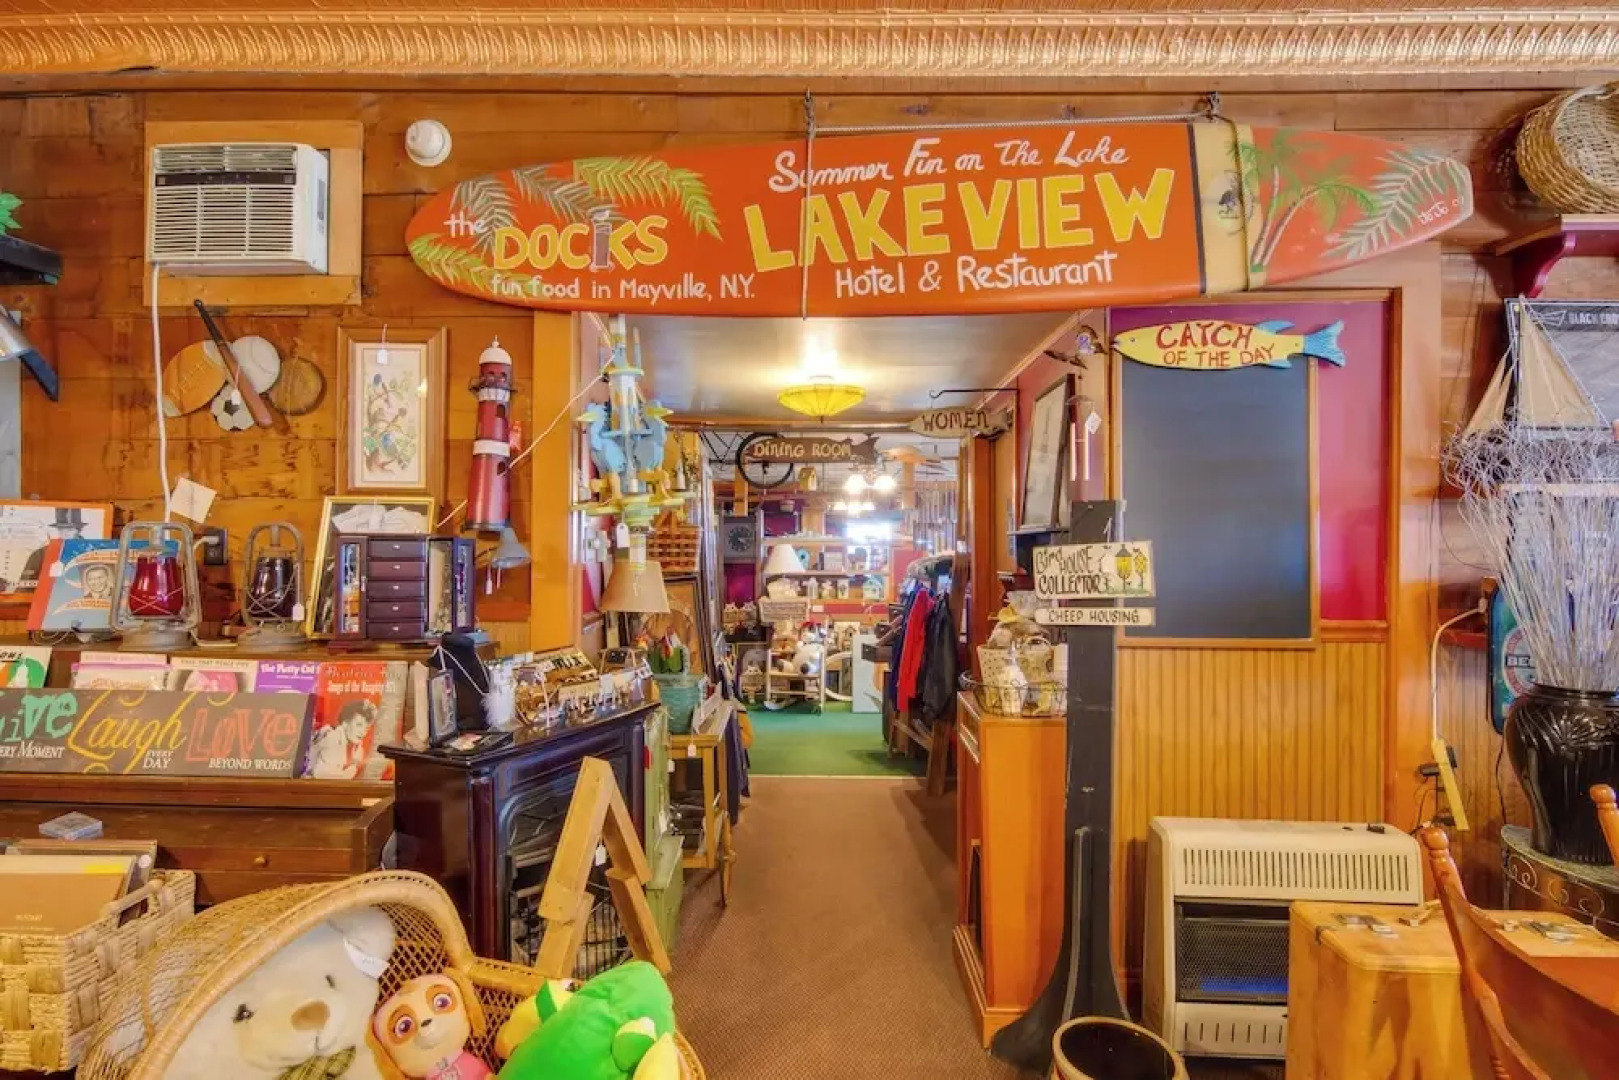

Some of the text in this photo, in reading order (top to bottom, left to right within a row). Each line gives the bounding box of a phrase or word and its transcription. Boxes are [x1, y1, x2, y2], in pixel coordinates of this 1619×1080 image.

[769, 150, 895, 193] Summer
[903, 137, 948, 178] Fun
[955, 152, 985, 173] on
[1053, 130, 1130, 166] Lake
[443, 209, 487, 238] the
[743, 168, 1176, 273] LAKEVIEW
[493, 210, 669, 273] DOCKS
[836, 249, 1118, 299] Hotel & Restaurant
[491, 273, 522, 298] fun
[529, 275, 580, 299] food
[592, 279, 612, 299] in
[619, 272, 713, 306] Mayville,
[1155, 321, 1254, 350] CATCH
[1163, 343, 1276, 368] OF THE DAY
[1048, 609, 1140, 624] CHEEP HOUSING
[142, 757, 171, 769] DAY
[208, 757, 292, 771] BEYOND WORDS
